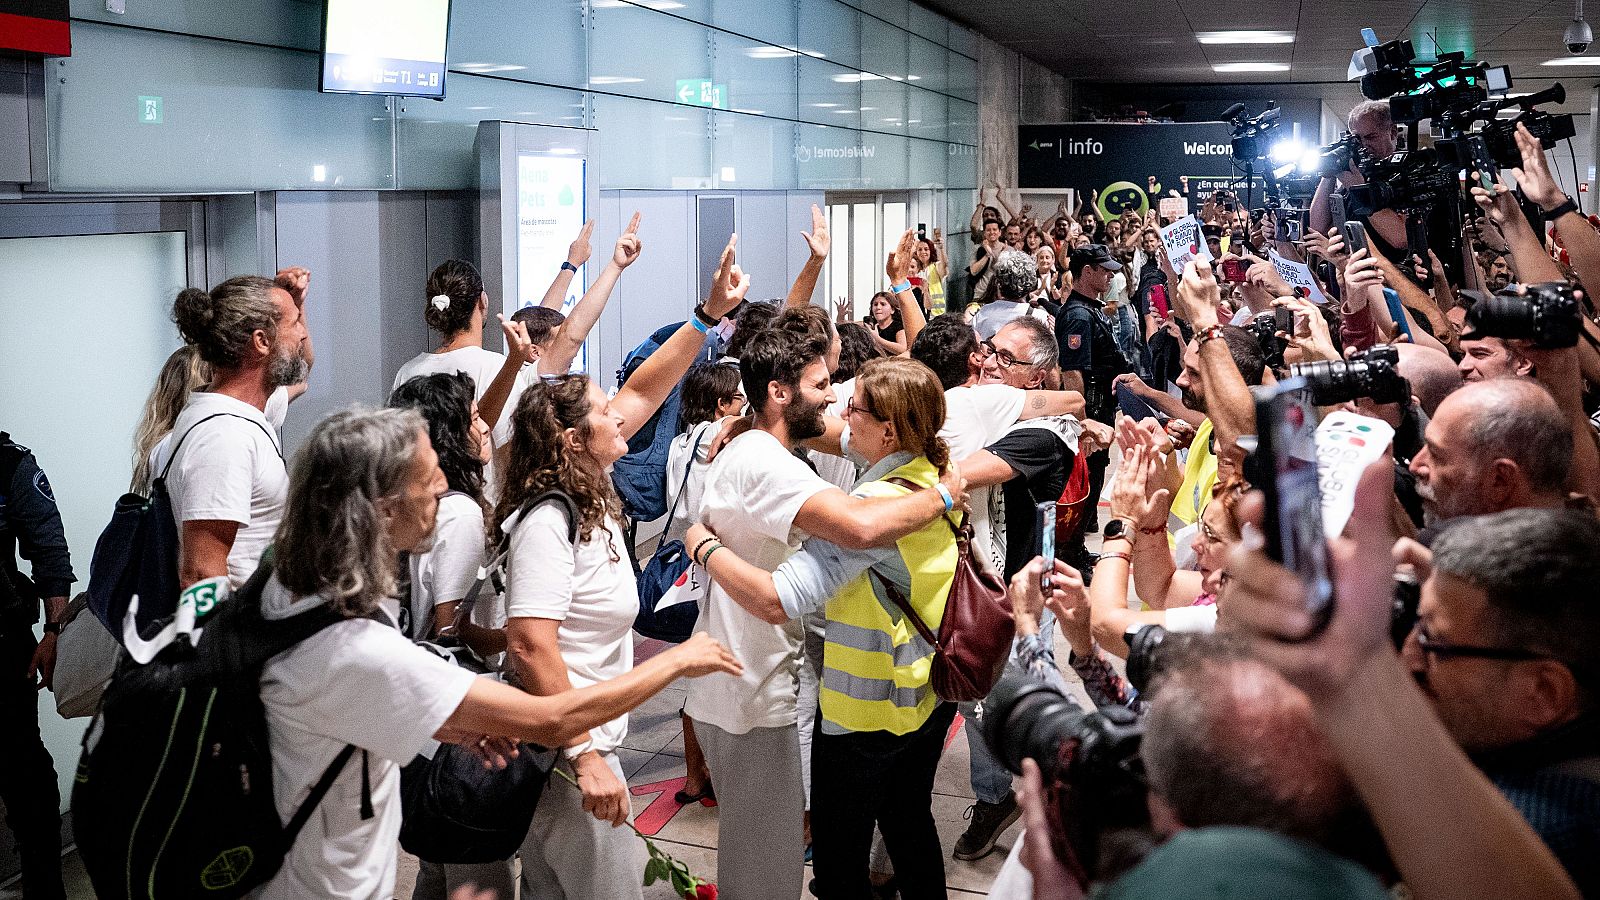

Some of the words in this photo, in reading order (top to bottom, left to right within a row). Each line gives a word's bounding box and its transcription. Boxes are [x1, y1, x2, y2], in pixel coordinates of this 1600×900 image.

[1069, 137, 1103, 155] info
[521, 166, 549, 183] Aena
[1213, 180, 1229, 190] qué
[521, 190, 545, 208] Pets
